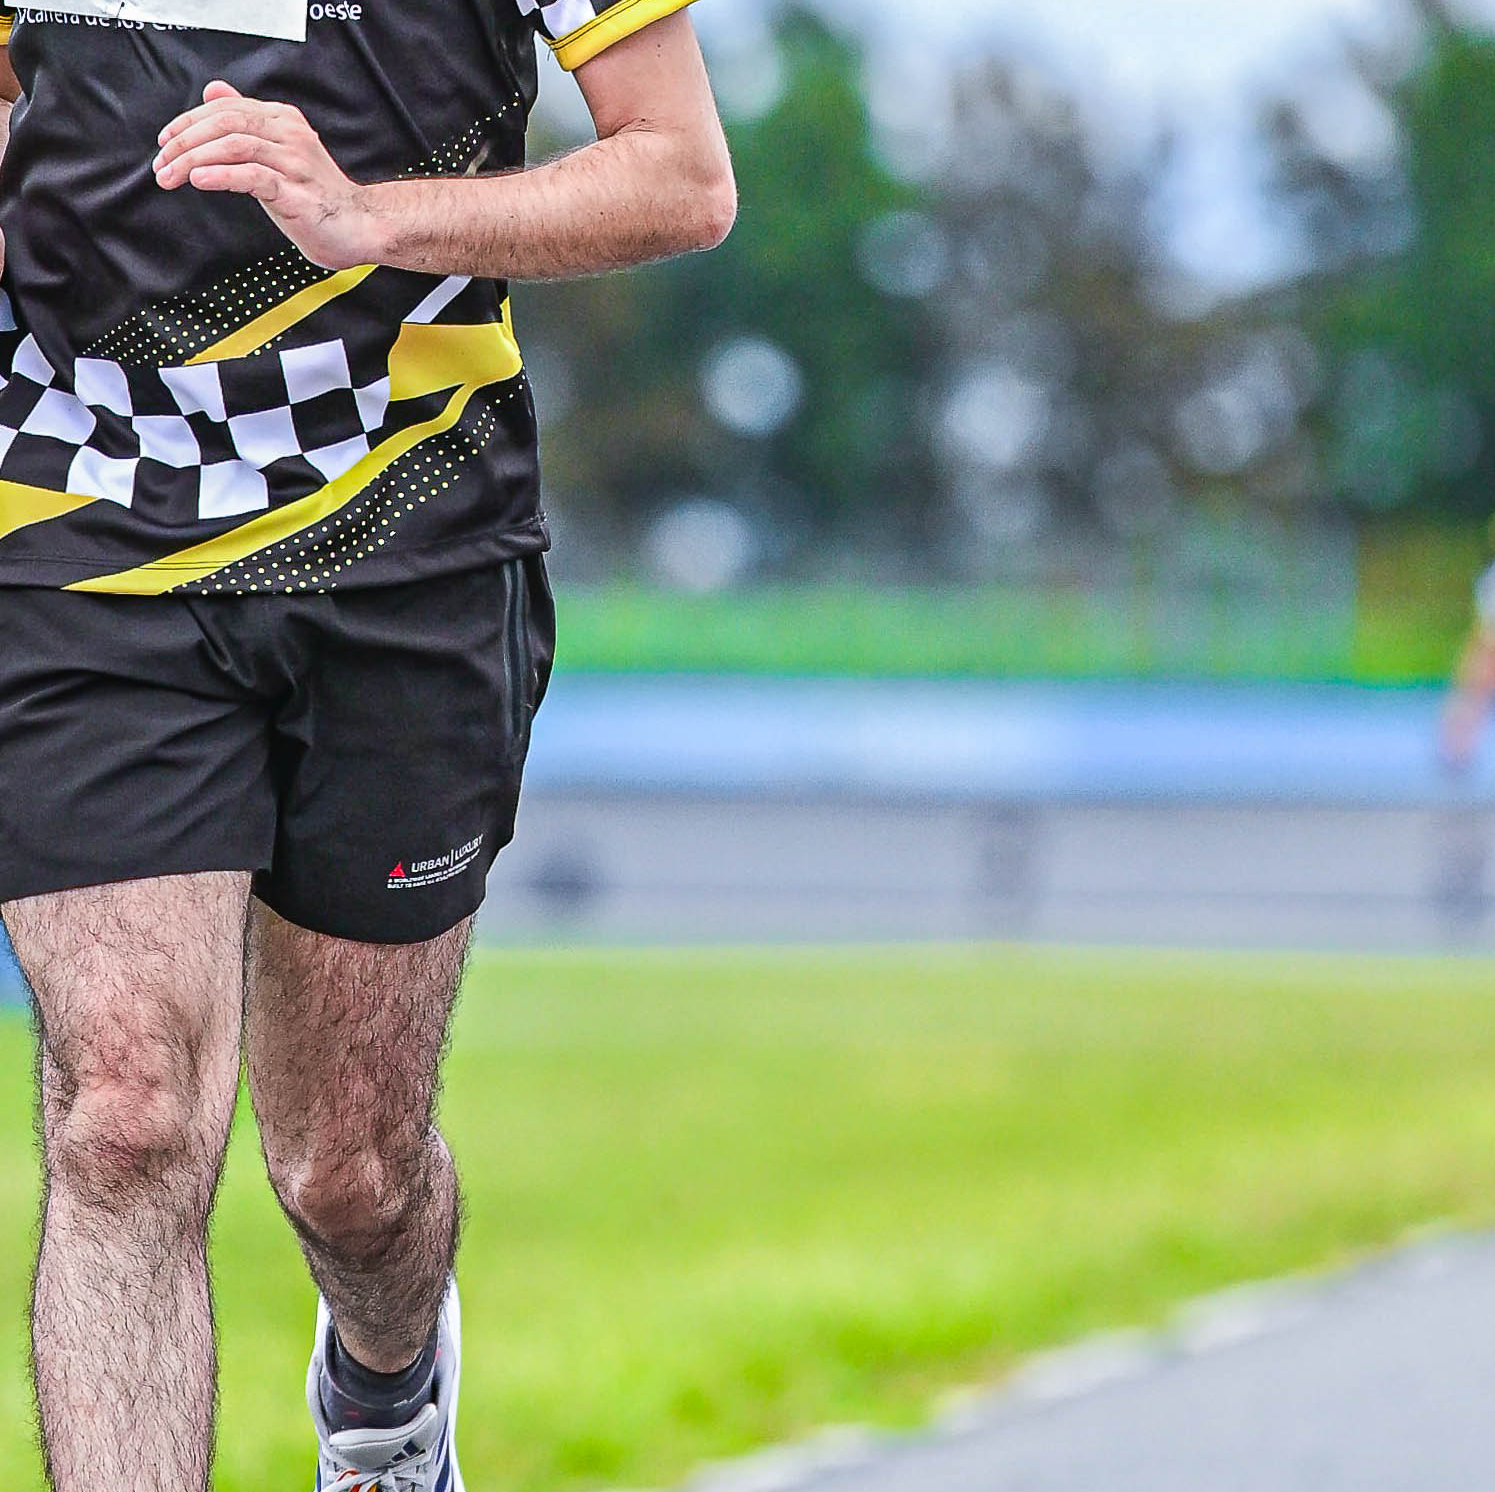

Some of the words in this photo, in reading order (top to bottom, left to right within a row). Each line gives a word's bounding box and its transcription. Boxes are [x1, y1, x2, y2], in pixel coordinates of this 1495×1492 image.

[309, 0, 362, 20] oeste
[411, 854, 450, 873] URBAN
[454, 833, 484, 861] LUXURY
